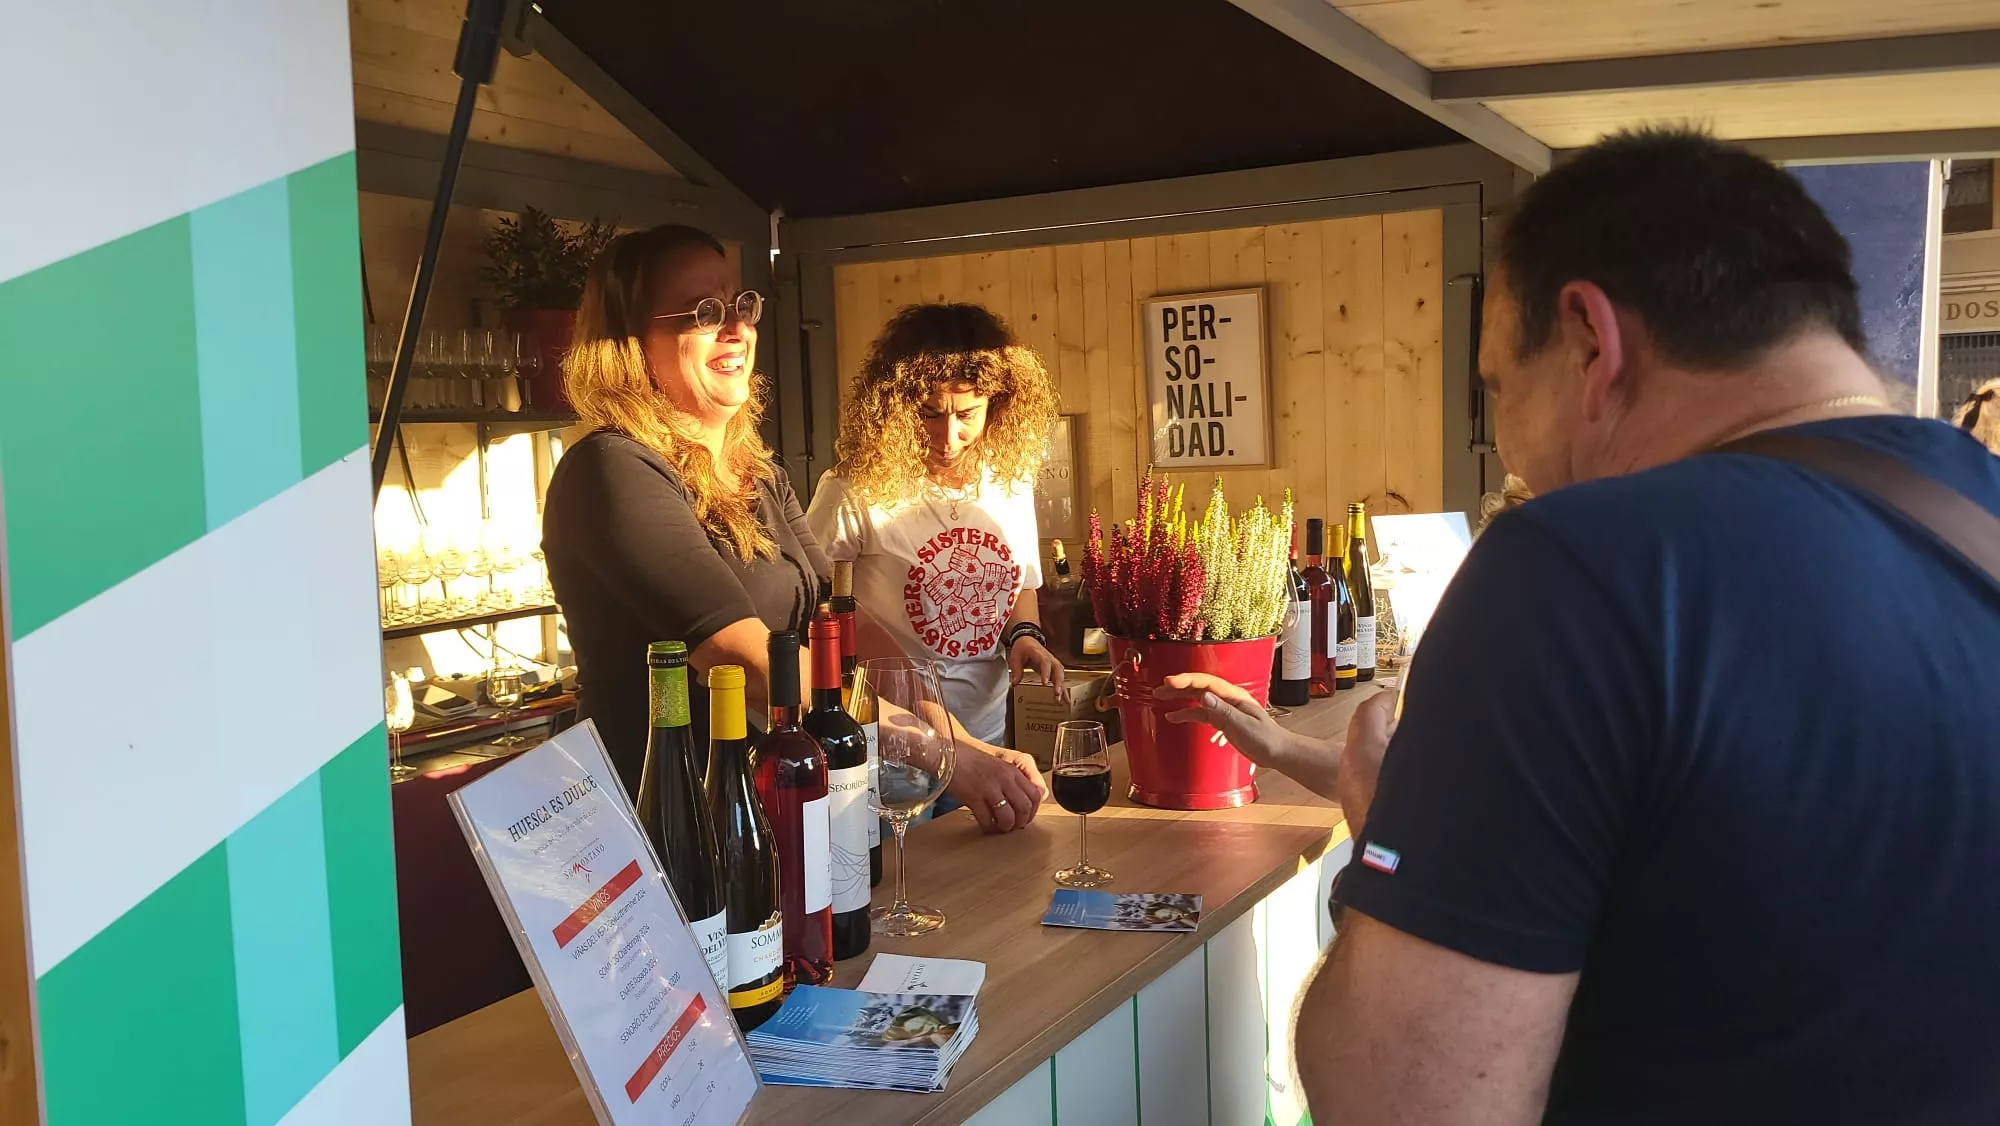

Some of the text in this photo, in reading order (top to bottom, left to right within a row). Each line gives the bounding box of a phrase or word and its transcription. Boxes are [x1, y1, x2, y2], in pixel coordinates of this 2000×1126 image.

[1162, 304, 1232, 343] PER-
[1945, 300, 1999, 321] DOS
[1165, 344, 1215, 381] SO-
[1166, 382, 1247, 419] NALI-
[1168, 421, 1234, 458] DAD.
[917, 527, 1012, 564] SISTERS
[904, 565, 962, 658] SISTERS
[508, 805, 552, 842] HUESCA
[549, 796, 564, 814] ES
[563, 774, 598, 806] DULCE
[707, 927, 727, 943] VIÑ
[751, 928, 782, 949] SOMM
[656, 1025, 681, 1060] PRECIOS
